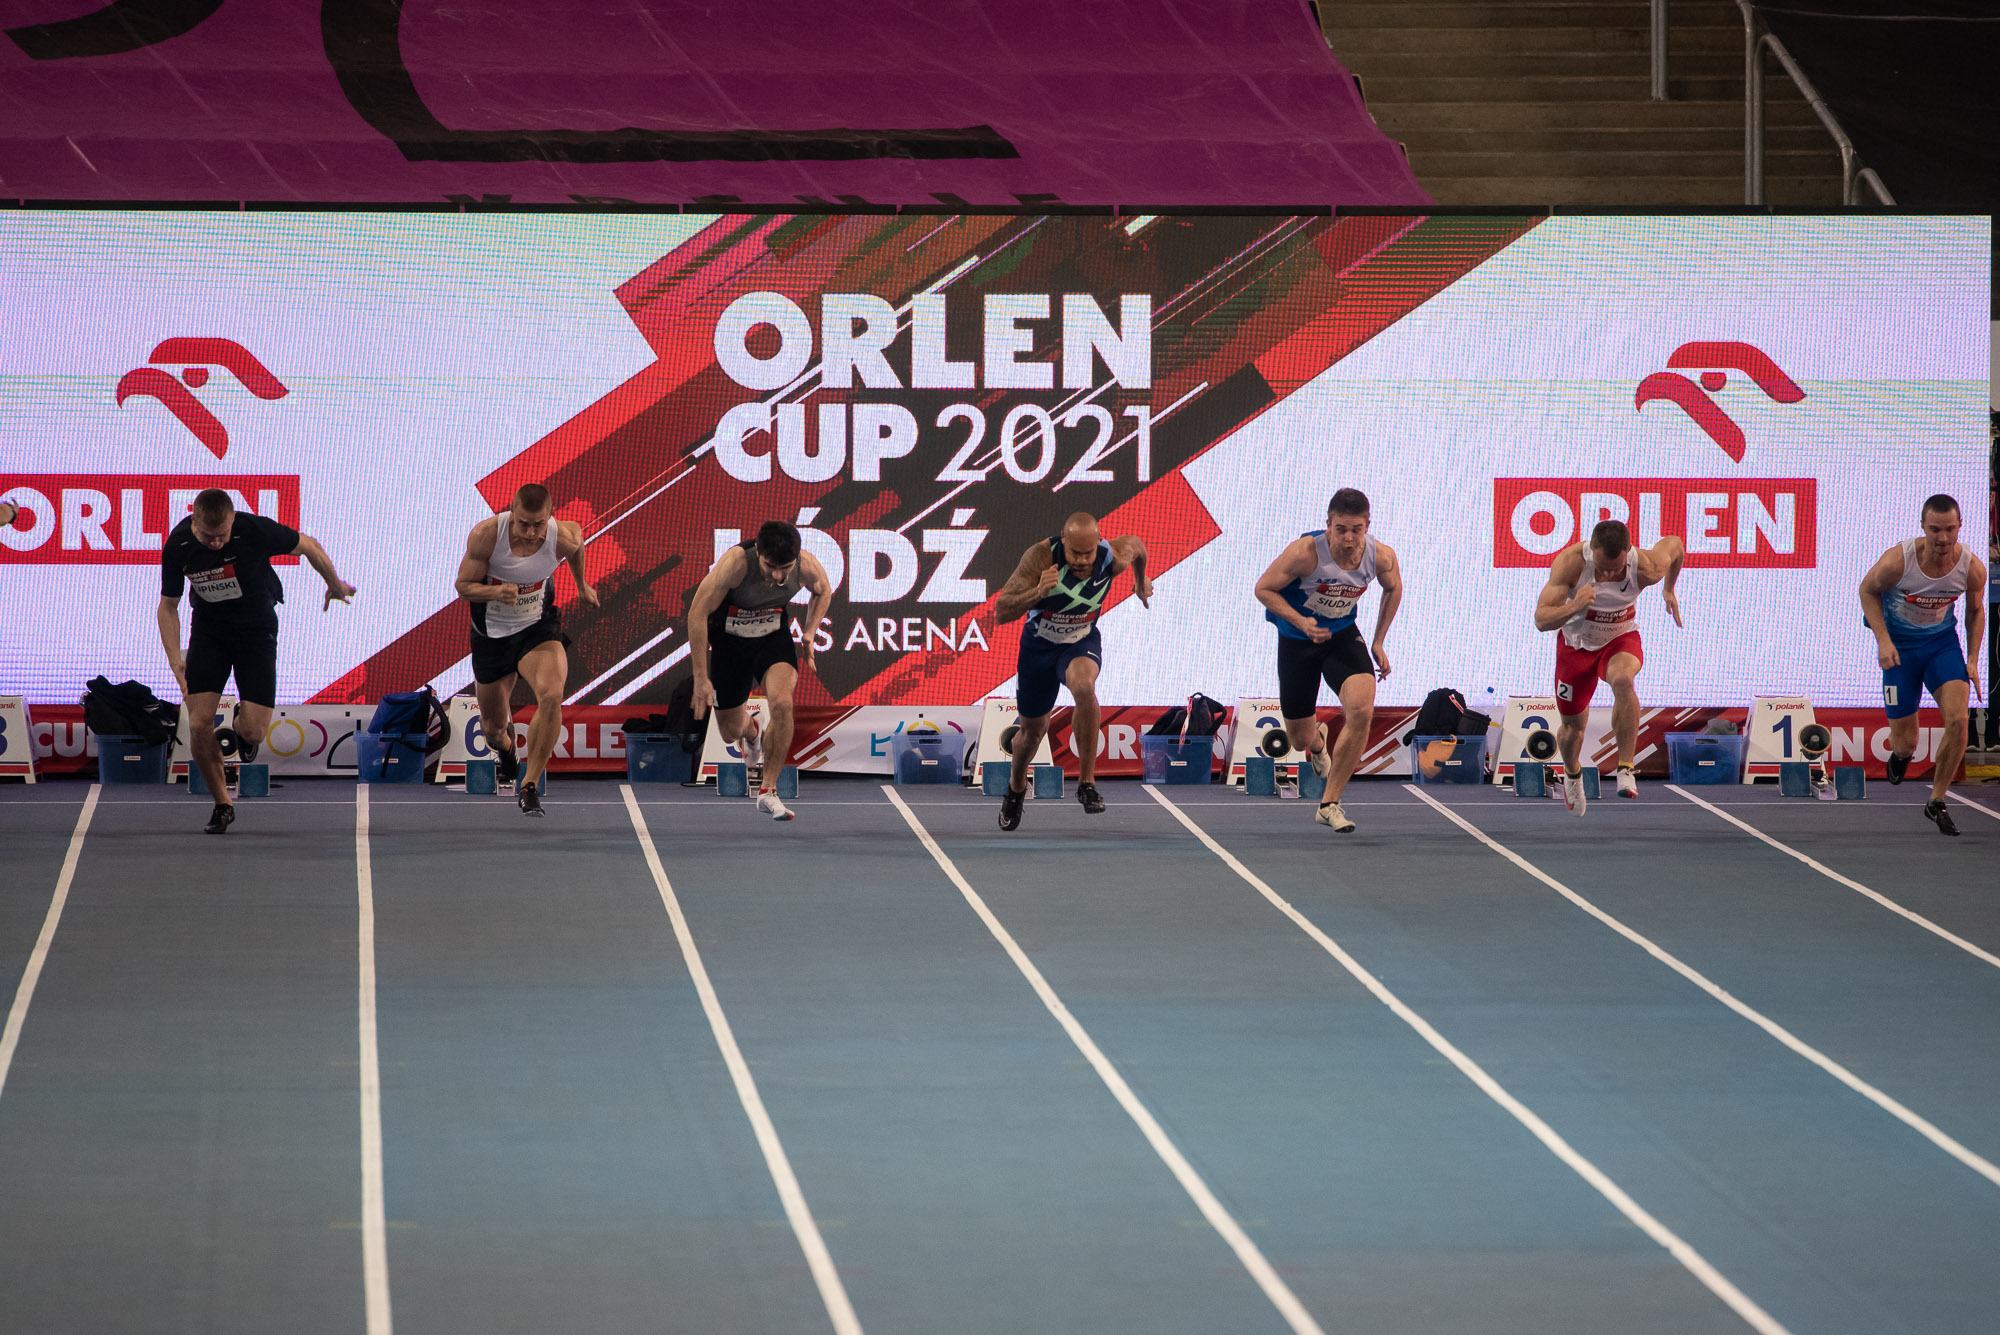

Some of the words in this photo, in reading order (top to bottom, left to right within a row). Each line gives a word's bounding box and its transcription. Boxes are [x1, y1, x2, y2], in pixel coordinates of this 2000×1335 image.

[714, 290, 1152, 391] ORLEN
[714, 402, 919, 483] CUP
[934, 402, 1151, 485] 2021
[709, 506, 990, 605] ÓDŹ
[1316, 597, 1352, 609] SIUDA
[844, 617, 989, 652] ARENA
[1559, 684, 1568, 699] 2
[1885, 687, 1892, 704] 1
[1260, 703, 1282, 712] polan
[1526, 703, 1556, 712] polanik
[1775, 702, 1805, 711] polanik
[464, 714, 492, 758] 6
[1772, 714, 1793, 759] 1
